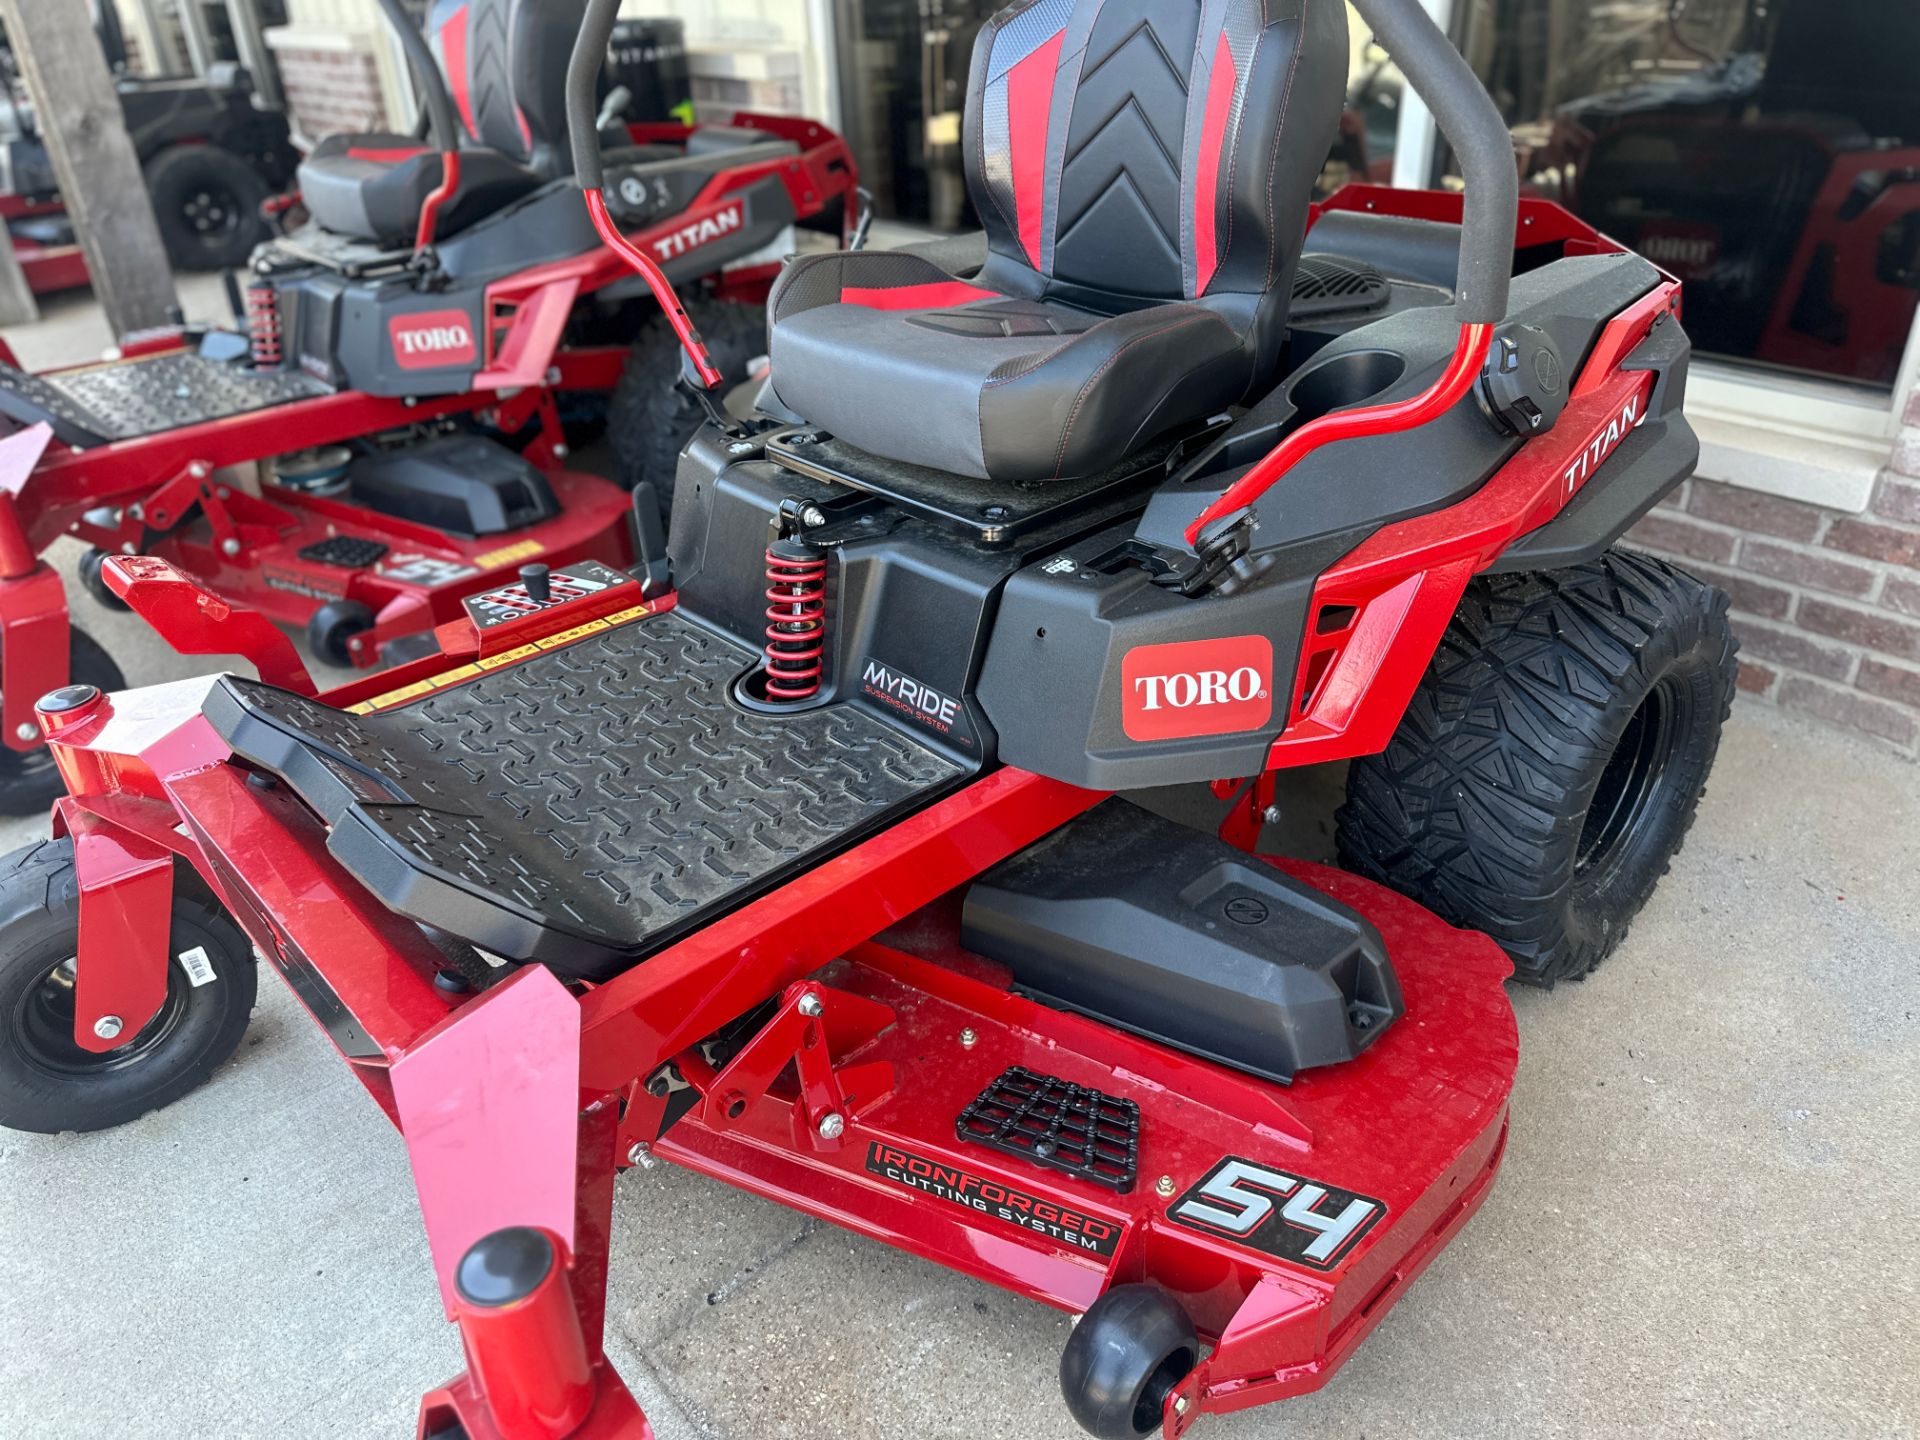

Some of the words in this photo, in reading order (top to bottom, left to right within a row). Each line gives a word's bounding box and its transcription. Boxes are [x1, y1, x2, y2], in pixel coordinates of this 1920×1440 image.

[653, 207, 739, 260] TITAN
[396, 325, 467, 353] TORO
[1565, 395, 1638, 493] TITAN
[864, 685, 913, 715] SUSPENSION
[915, 711, 949, 734] SYSTEM
[887, 1168, 987, 1212] CUTTING
[998, 1208, 1097, 1251] SYSTEM
[1176, 1160, 1377, 1263] 54
